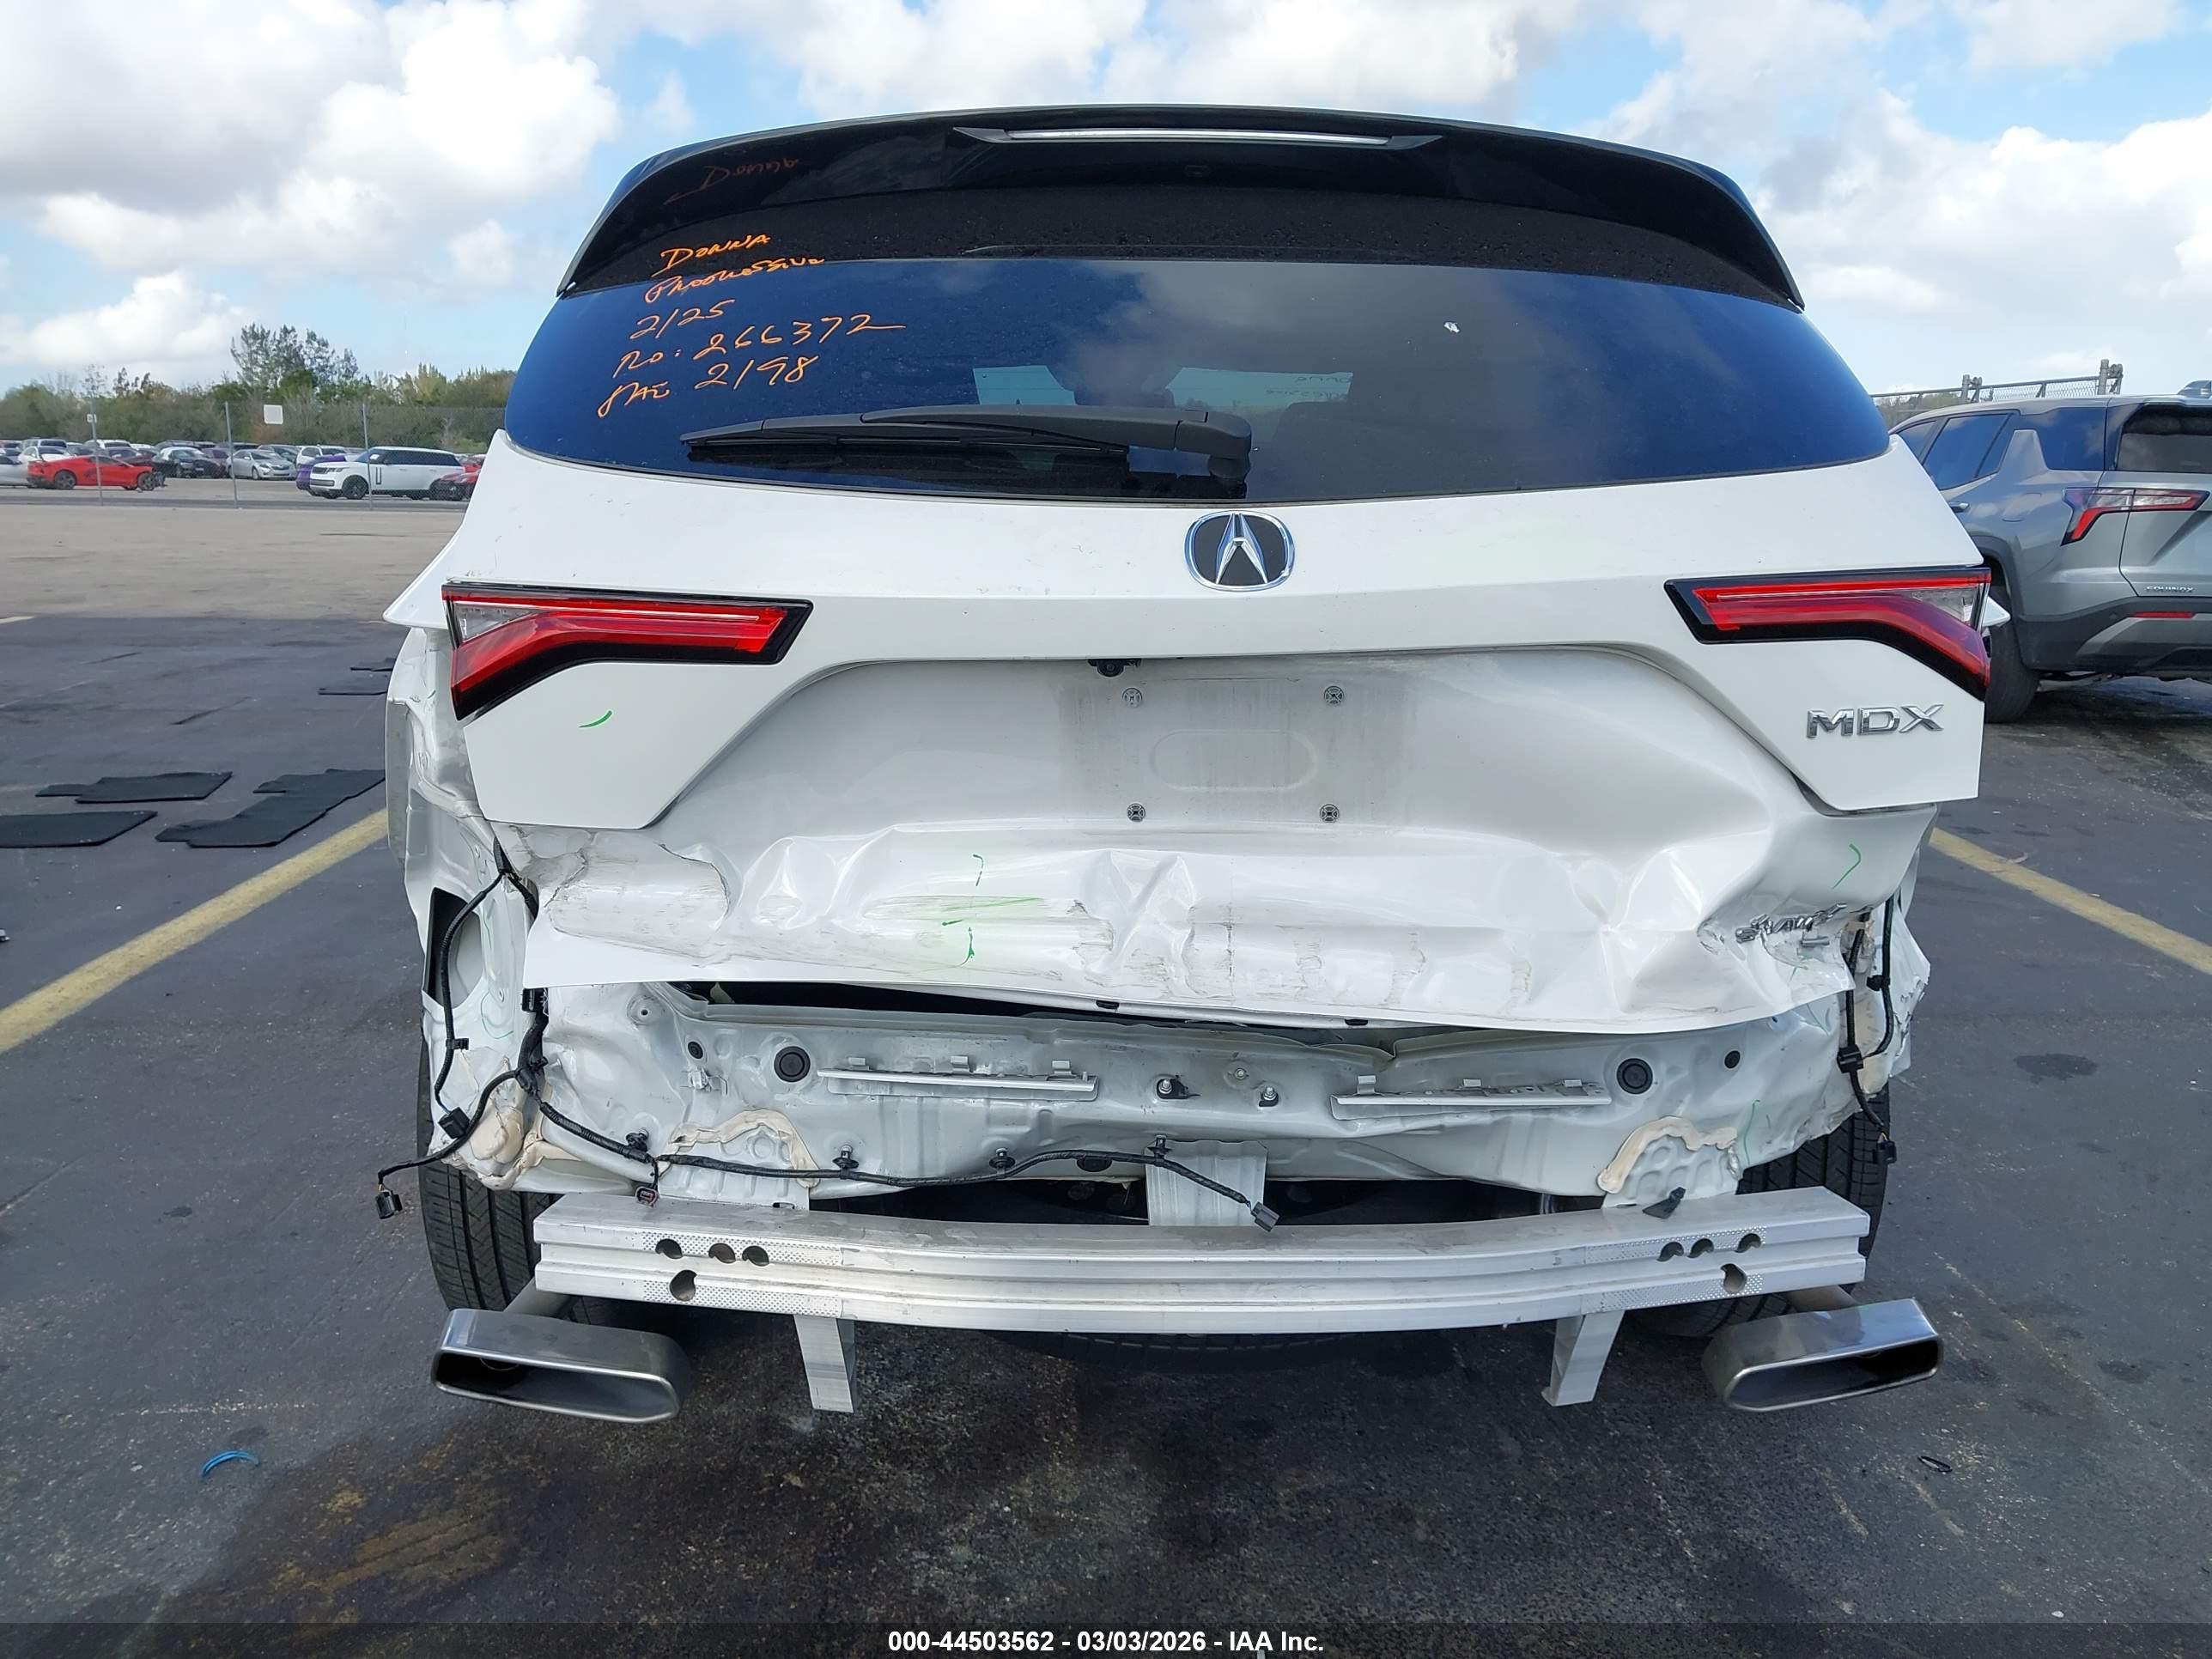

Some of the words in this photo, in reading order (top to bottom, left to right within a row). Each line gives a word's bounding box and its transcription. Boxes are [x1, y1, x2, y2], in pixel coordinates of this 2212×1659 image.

[629, 299, 736, 340] 2/25
[695, 356, 819, 390] 2198
[1806, 703, 1945, 738] MDX
